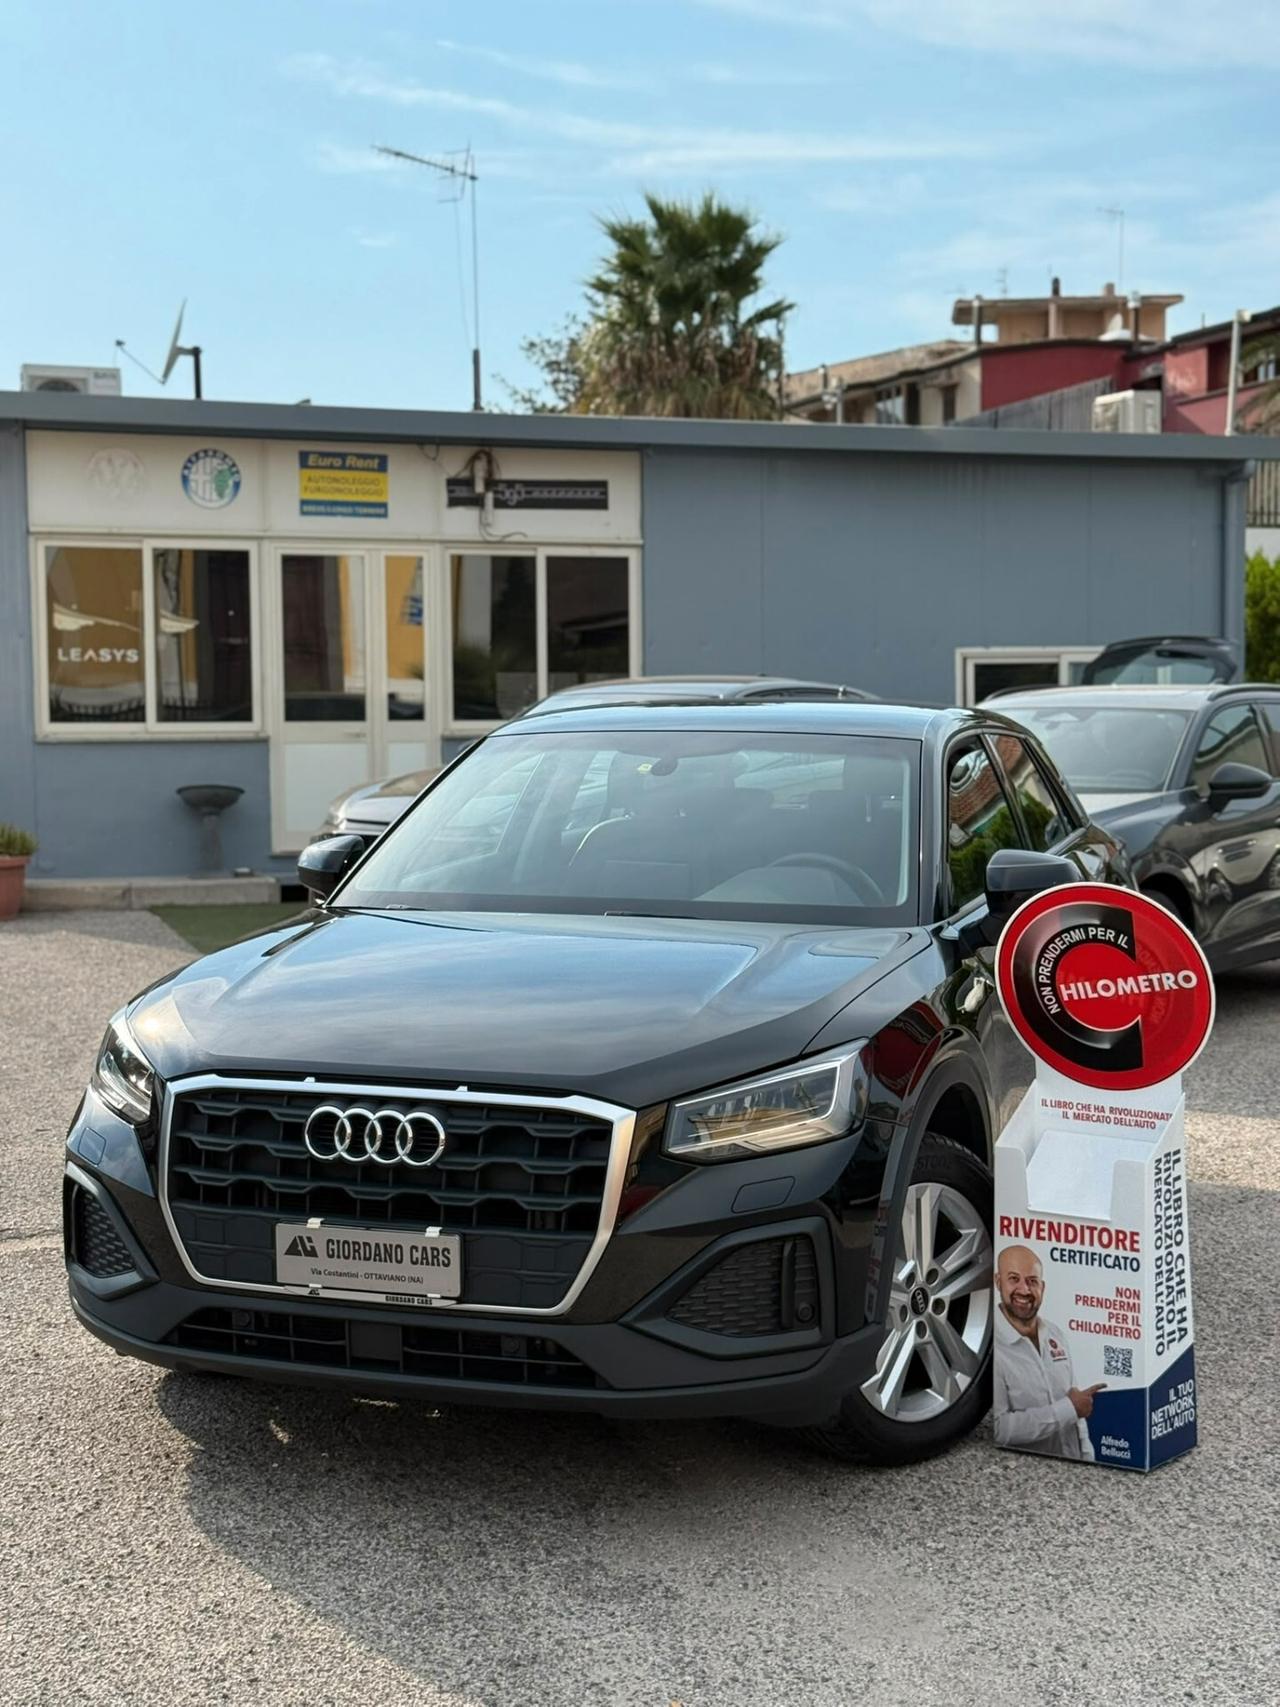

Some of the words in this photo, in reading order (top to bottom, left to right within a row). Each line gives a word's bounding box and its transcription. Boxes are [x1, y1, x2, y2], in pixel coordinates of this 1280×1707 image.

[308, 454, 341, 467] Euro
[345, 455, 379, 469] Rent
[57, 647, 139, 663] LEASYS
[1088, 927, 1116, 942] PER
[1118, 934, 1130, 949] IL
[1038, 929, 1086, 984] PRENDERMI
[1060, 970, 1198, 1001] HILOMETRO
[1041, 986, 1061, 1014] NON
[1041, 1098, 1049, 1108] IL
[1050, 1100, 1074, 1110] LIBRO
[1075, 1102, 1092, 1112] CHE
[1094, 1104, 1106, 1114] HA
[1062, 1111, 1070, 1119] IL
[1073, 1112, 1112, 1125] MERCATO
[1113, 1117, 1156, 1130] DELL'AUTO
[1172, 1149, 1182, 1171] IL
[1154, 1157, 1163, 1250] MERCATO
[1173, 1175, 1184, 1247] LIBRO
[999, 1216, 1141, 1252] RIVENDITORE
[1163, 1151, 1176, 1325] RIVOLUZIONATO
[326, 1238, 403, 1264] GIORDANO
[410, 1245, 451, 1268] CARS
[1050, 1247, 1141, 1273] CERTIFICATO
[310, 1268, 322, 1276] Via
[323, 1268, 359, 1279] Costantini
[364, 1272, 406, 1282] OTTAVIANO
[408, 1274, 424, 1285] (NA)
[1174, 1253, 1187, 1299] CHE
[385, 1295, 415, 1304] GIORDANO
[417, 1297, 432, 1305] CARS
[1075, 1294, 1141, 1314] PRENDERMI
[1115, 1286, 1141, 1300] NON
[1154, 1255, 1164, 1356] DELL'AUTO
[1068, 1319, 1141, 1340] CHILOMETRO
[1107, 1311, 1129, 1325] PER
[1131, 1314, 1142, 1327] IL
[1176, 1306, 1188, 1343] HA
[1166, 1329, 1177, 1350] IL
[1169, 1388, 1177, 1401] IL
[1177, 1379, 1194, 1397] TUO
[1151, 1393, 1195, 1425] NETWORK
[1151, 1408, 1195, 1440] DELL'AUTO
[1100, 1435, 1130, 1449] Alfredo
[1101, 1445, 1131, 1459] Bellucci
